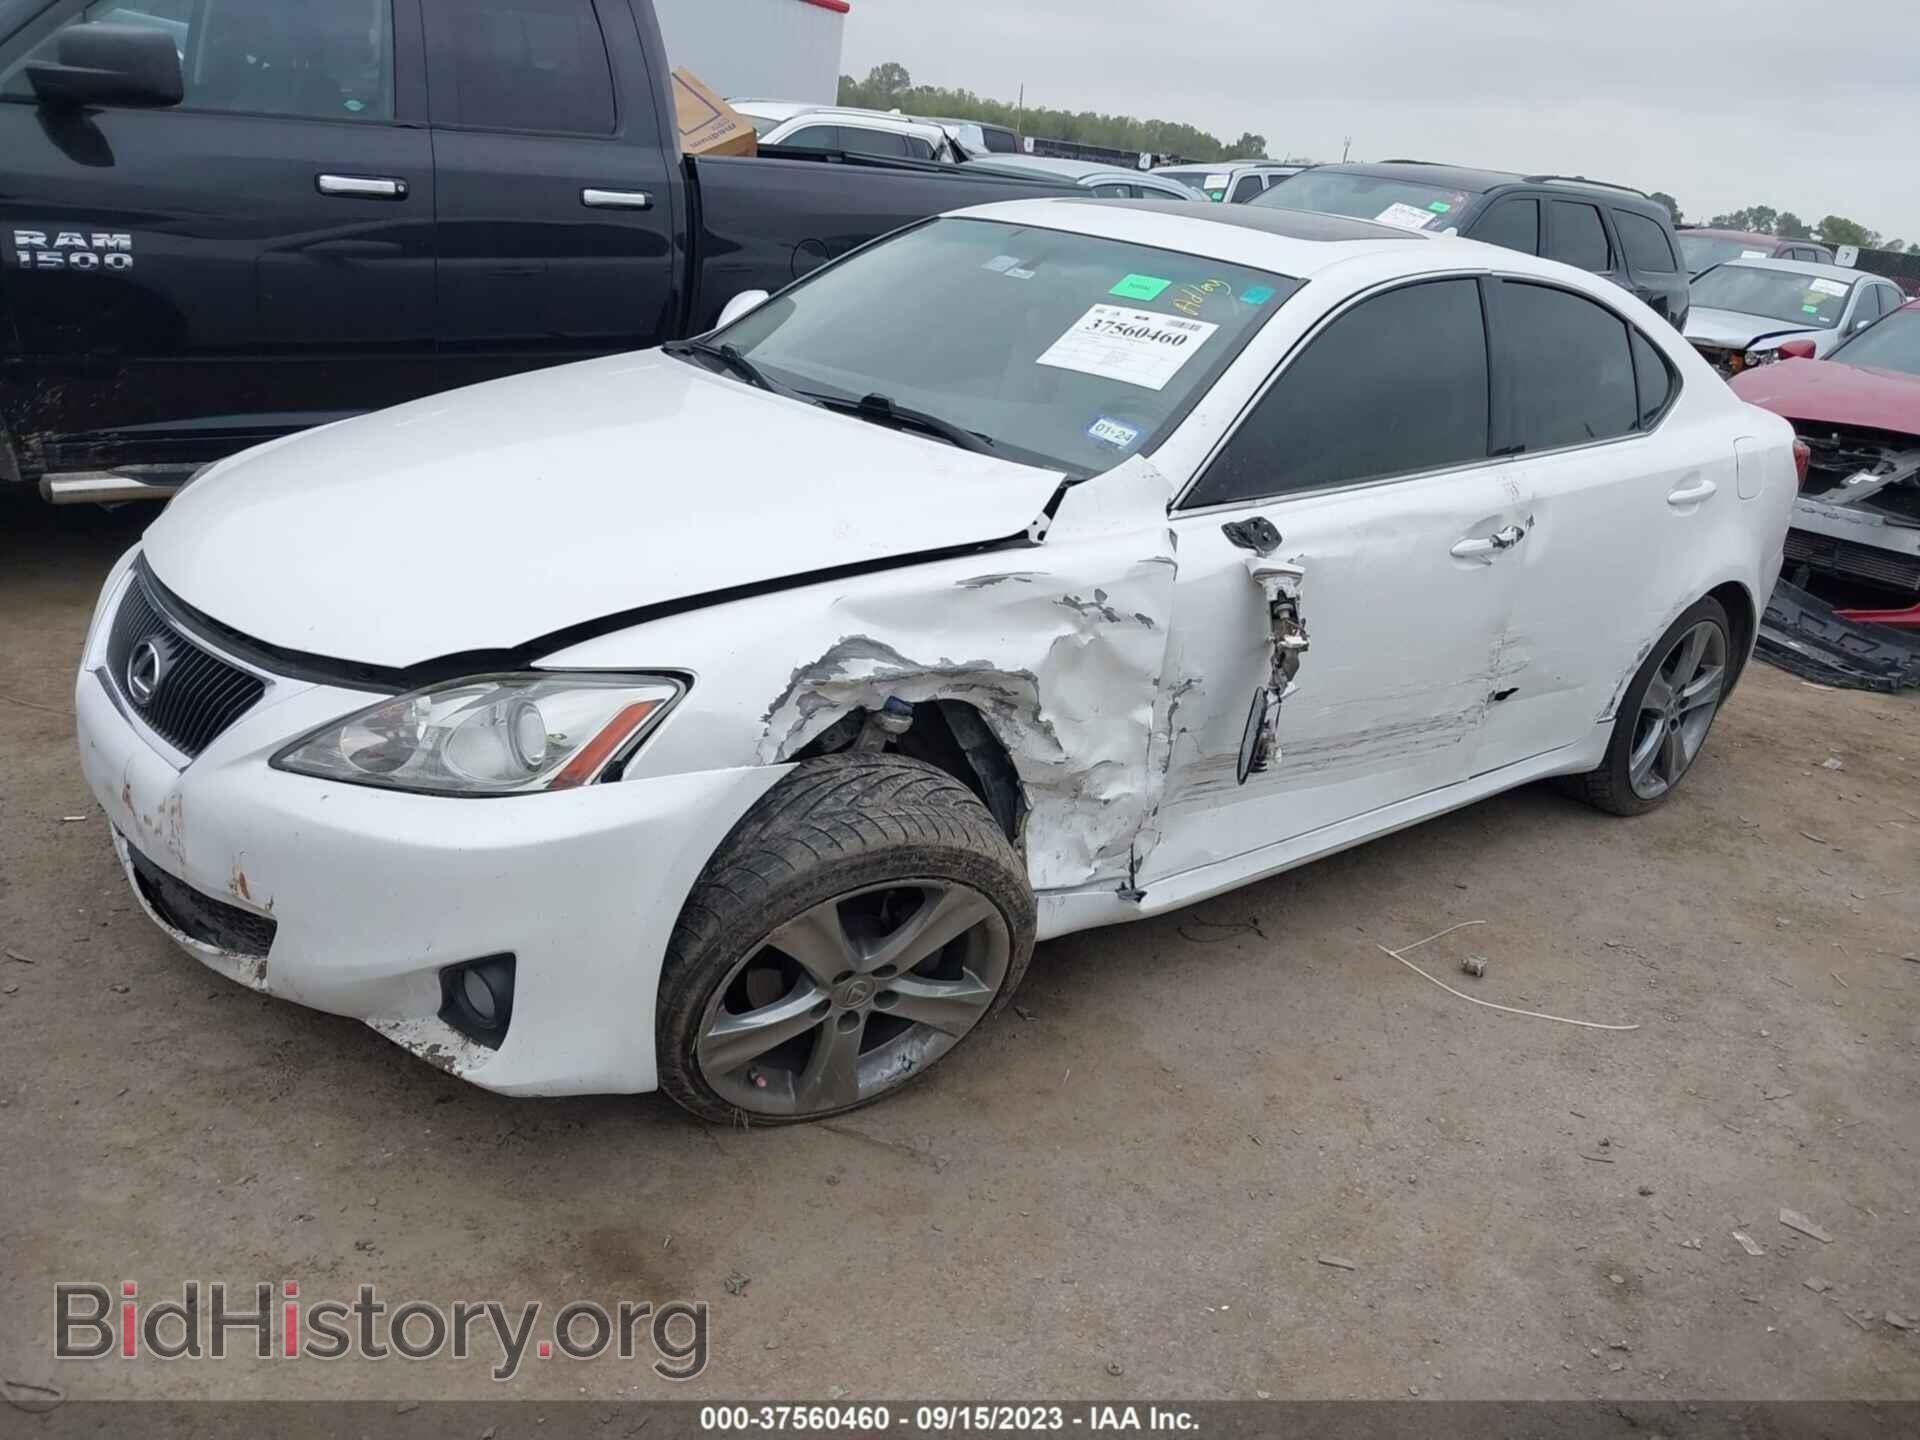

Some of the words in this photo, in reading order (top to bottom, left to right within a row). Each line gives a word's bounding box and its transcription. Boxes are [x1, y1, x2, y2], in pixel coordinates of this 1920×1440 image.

[13, 230, 132, 250] RAM
[16, 250, 134, 272] 1500
[1085, 318, 1188, 347] 37560460
